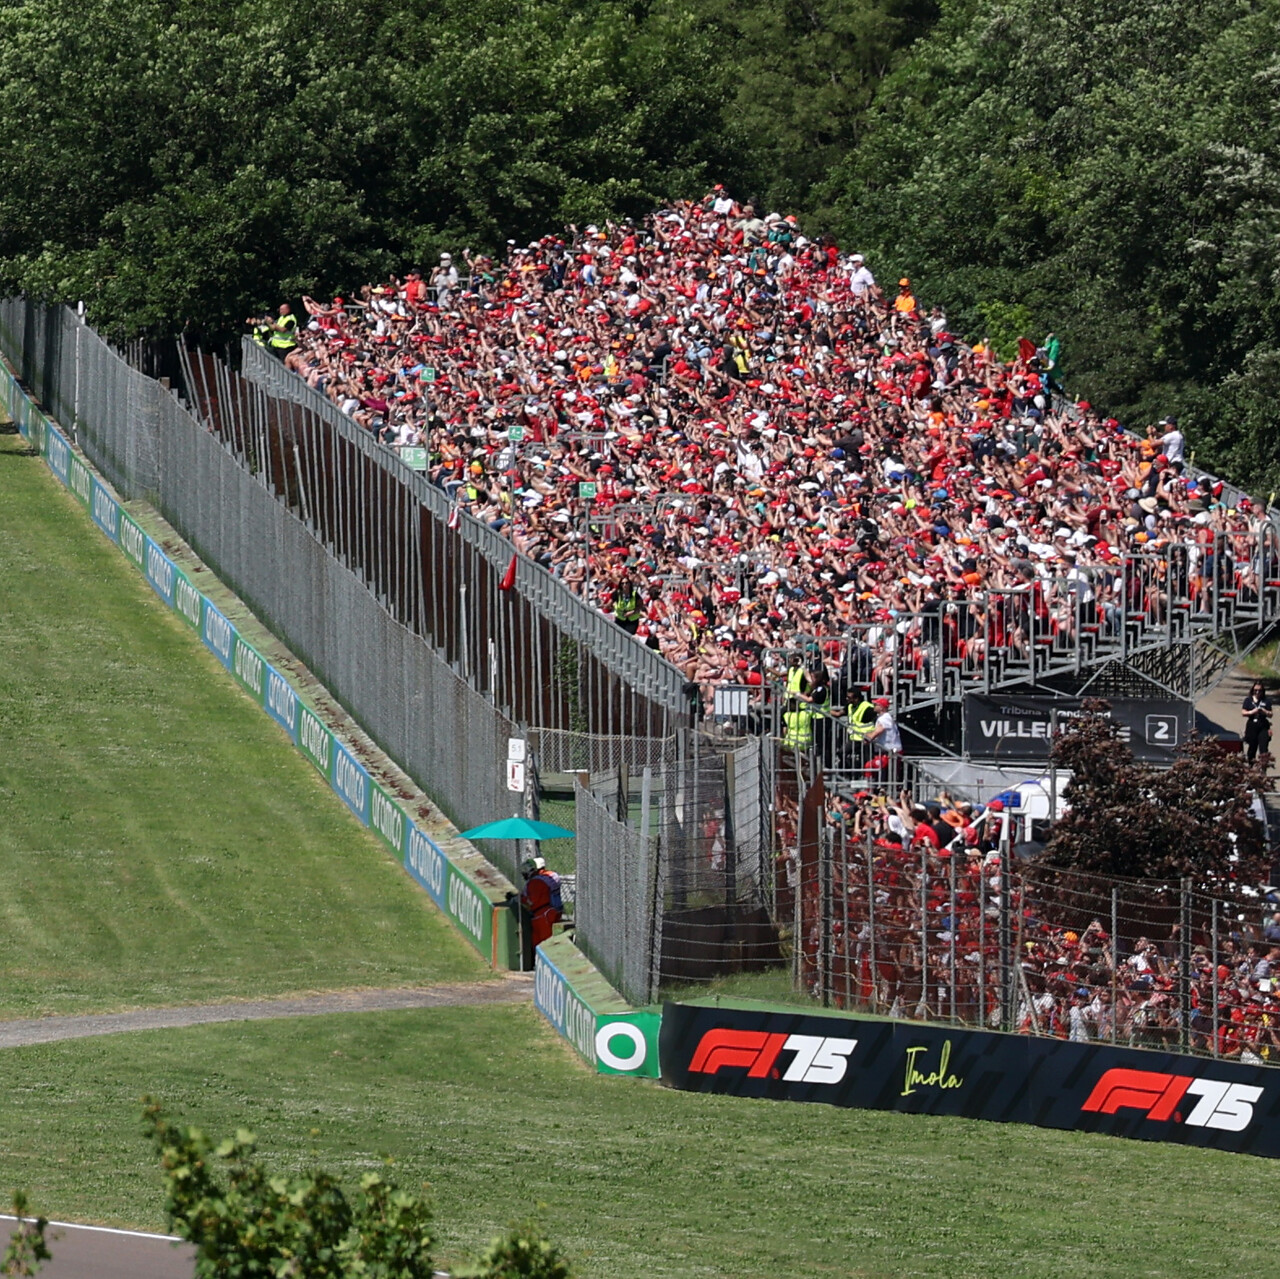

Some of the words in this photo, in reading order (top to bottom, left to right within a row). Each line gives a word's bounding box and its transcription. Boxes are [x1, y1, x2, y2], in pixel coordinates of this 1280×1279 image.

[301, 710, 329, 769] aramco
[1000, 706, 1042, 715] Tribuna
[1154, 721, 1169, 740] 2
[336, 749, 364, 812] aramco
[372, 788, 402, 851] aramco
[409, 828, 442, 895] aramco
[449, 872, 483, 941] aramco
[536, 953, 564, 1027] amco
[783, 1035, 858, 1084] 75
[899, 1039, 963, 1097] Imola
[1185, 1078, 1264, 1131] 75
